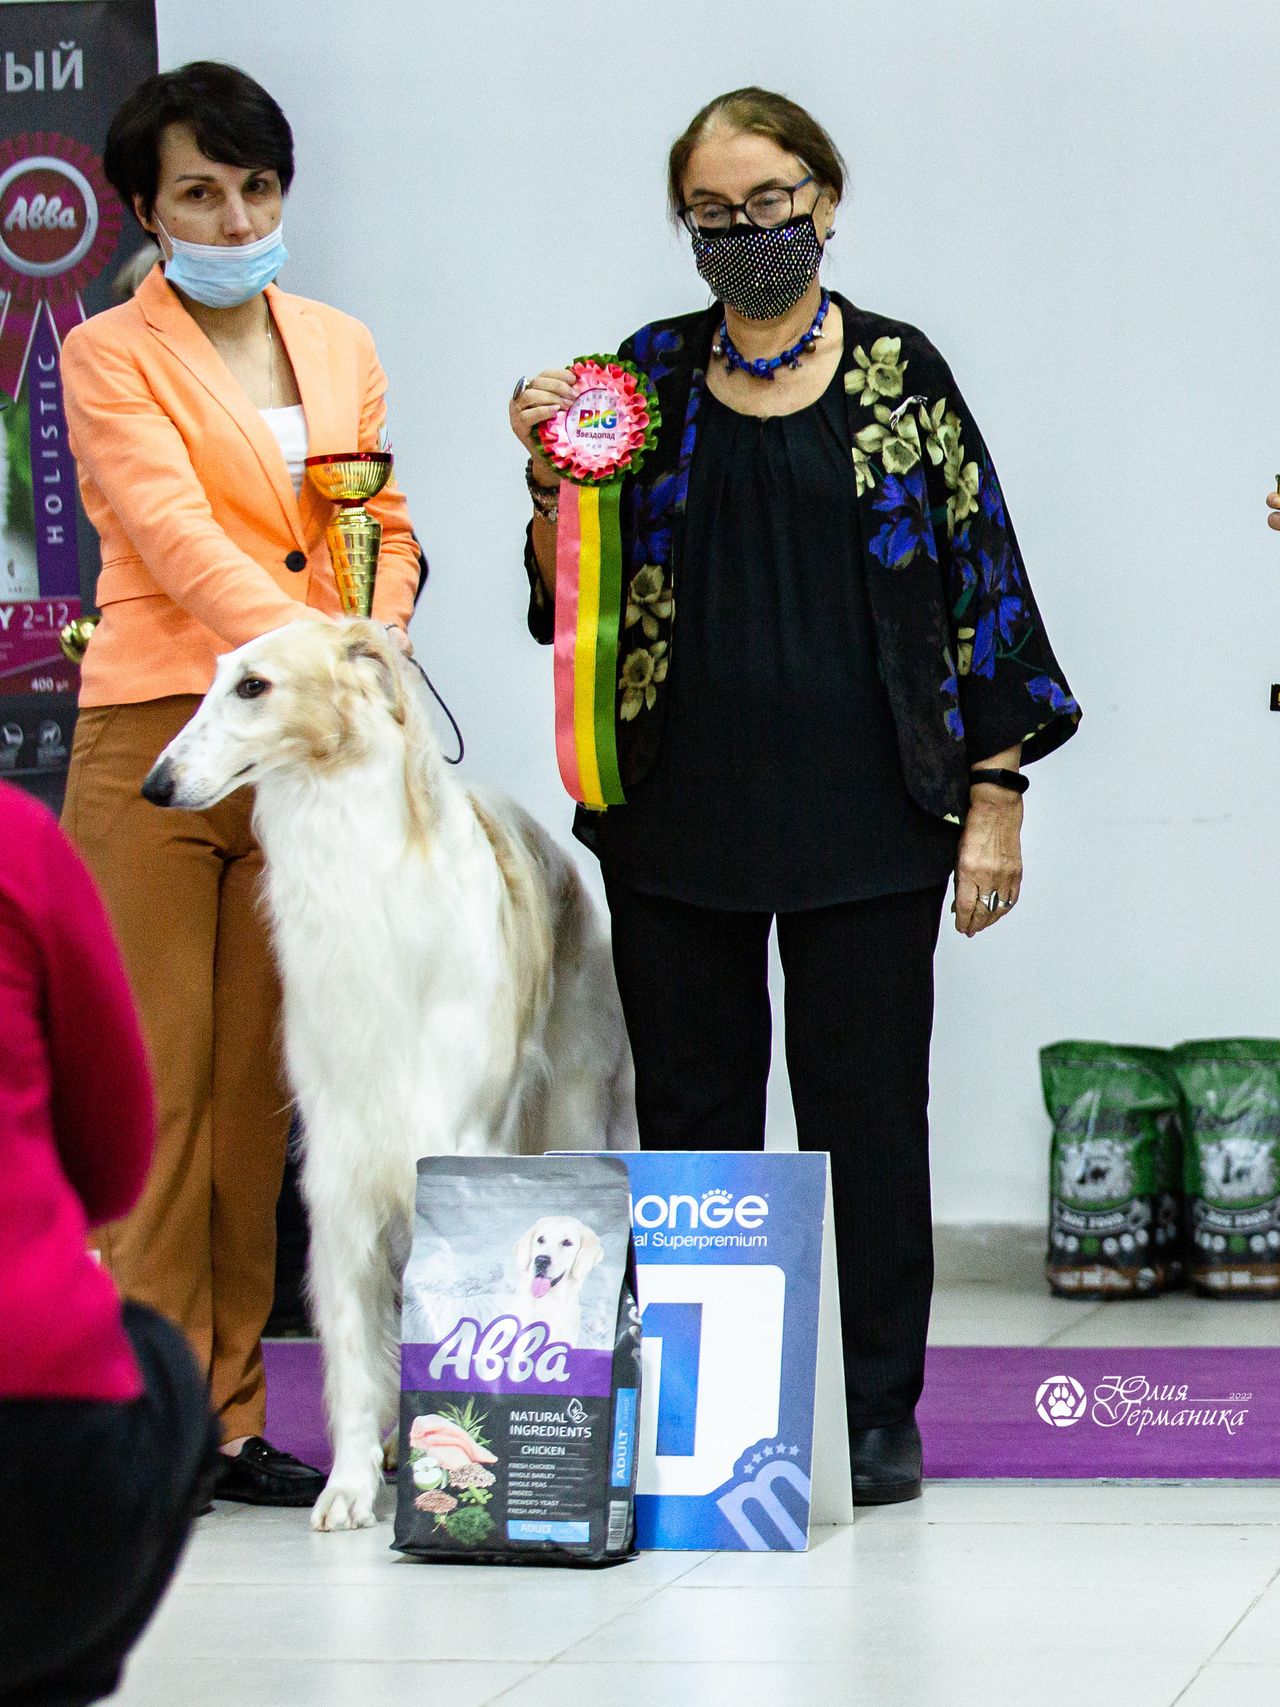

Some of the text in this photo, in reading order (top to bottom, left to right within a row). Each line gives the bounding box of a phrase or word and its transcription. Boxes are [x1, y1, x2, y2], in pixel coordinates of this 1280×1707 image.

[579, 409, 617, 429] BIG
[576, 429, 616, 440] Звездопад
[38, 354, 64, 544] HOLISTIC
[31, 677, 54, 692] 400
[652, 1231, 768, 1248] Superpremium
[640, 1303, 703, 1456] 1
[510, 1411, 568, 1423] NATURAL
[509, 1424, 592, 1438] INGREDIENTS
[521, 1445, 566, 1456] CHICKEN
[616, 1430, 629, 1479] ADULT
[508, 1462, 528, 1470] FRESH
[520, 1523, 553, 1534] ADULT
